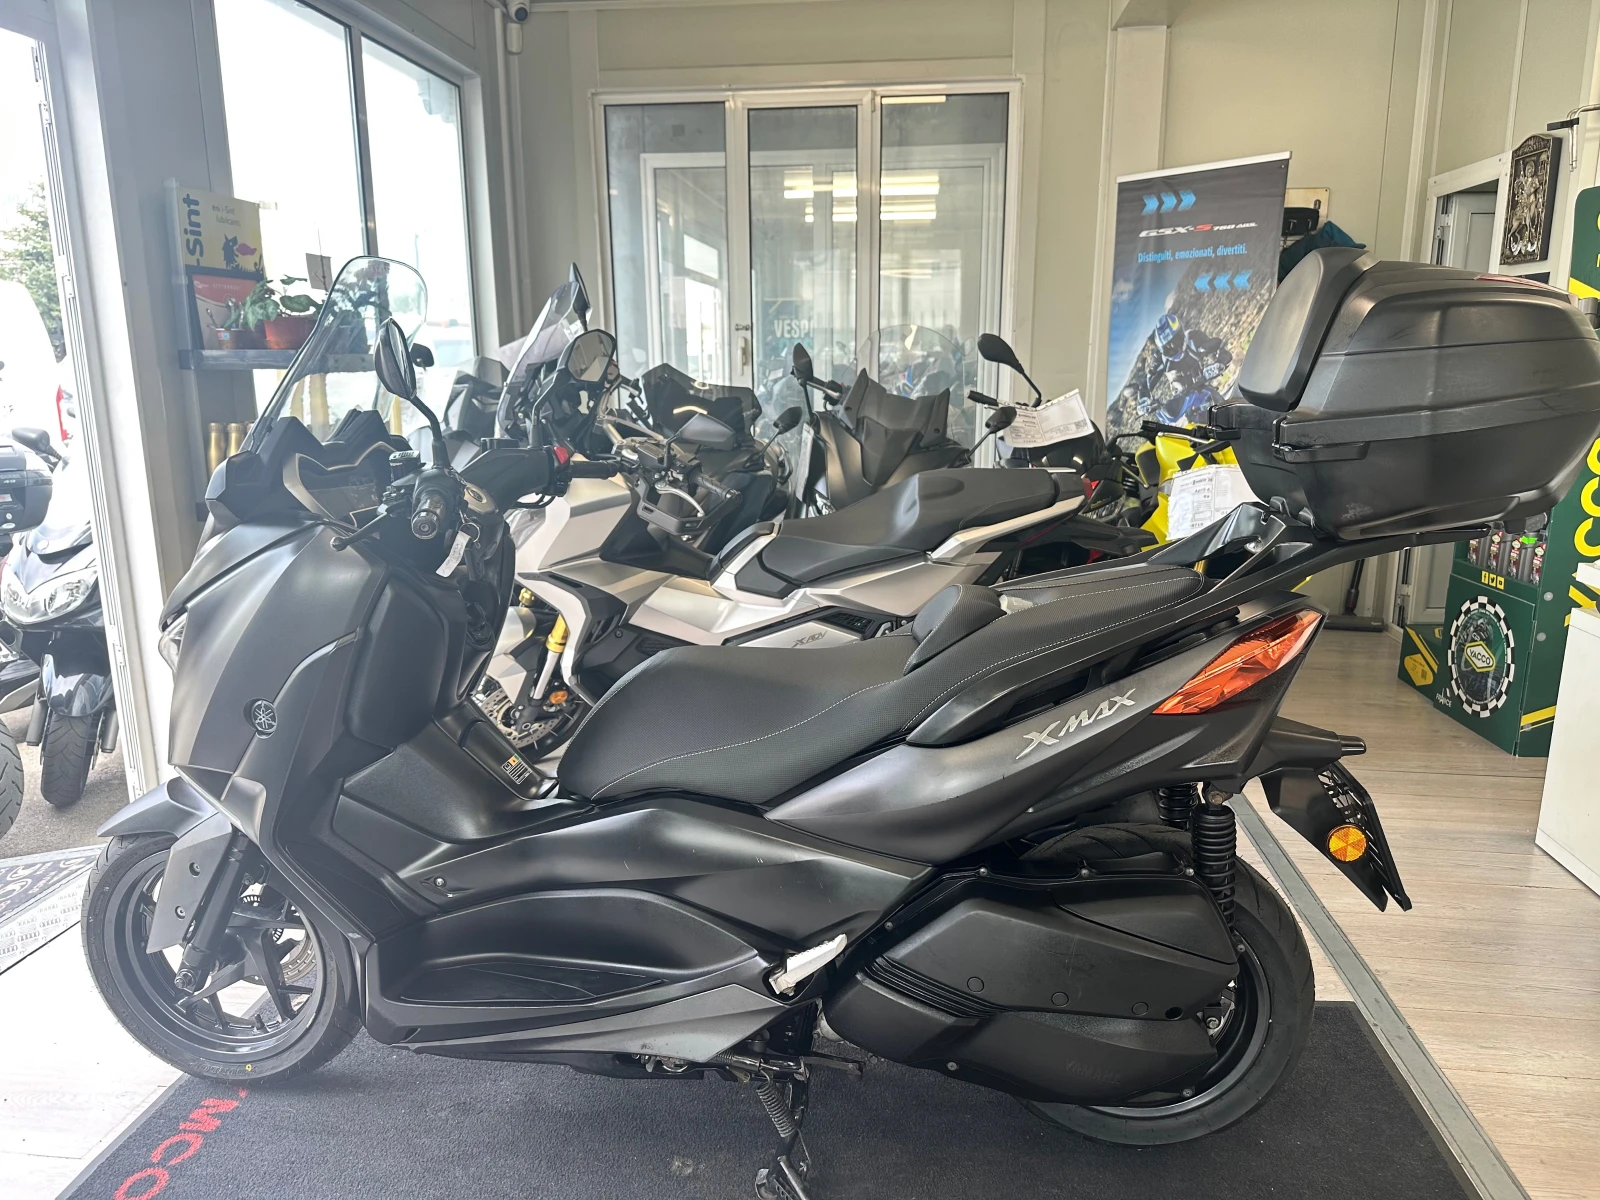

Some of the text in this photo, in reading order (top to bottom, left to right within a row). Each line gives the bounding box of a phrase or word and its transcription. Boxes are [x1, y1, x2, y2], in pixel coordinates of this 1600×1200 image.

[1138, 243, 1247, 263] Distinguiti, emozionati, divertiti.
[1469, 648, 1491, 666] YACCO
[114, 1087, 247, 1200] MCO
